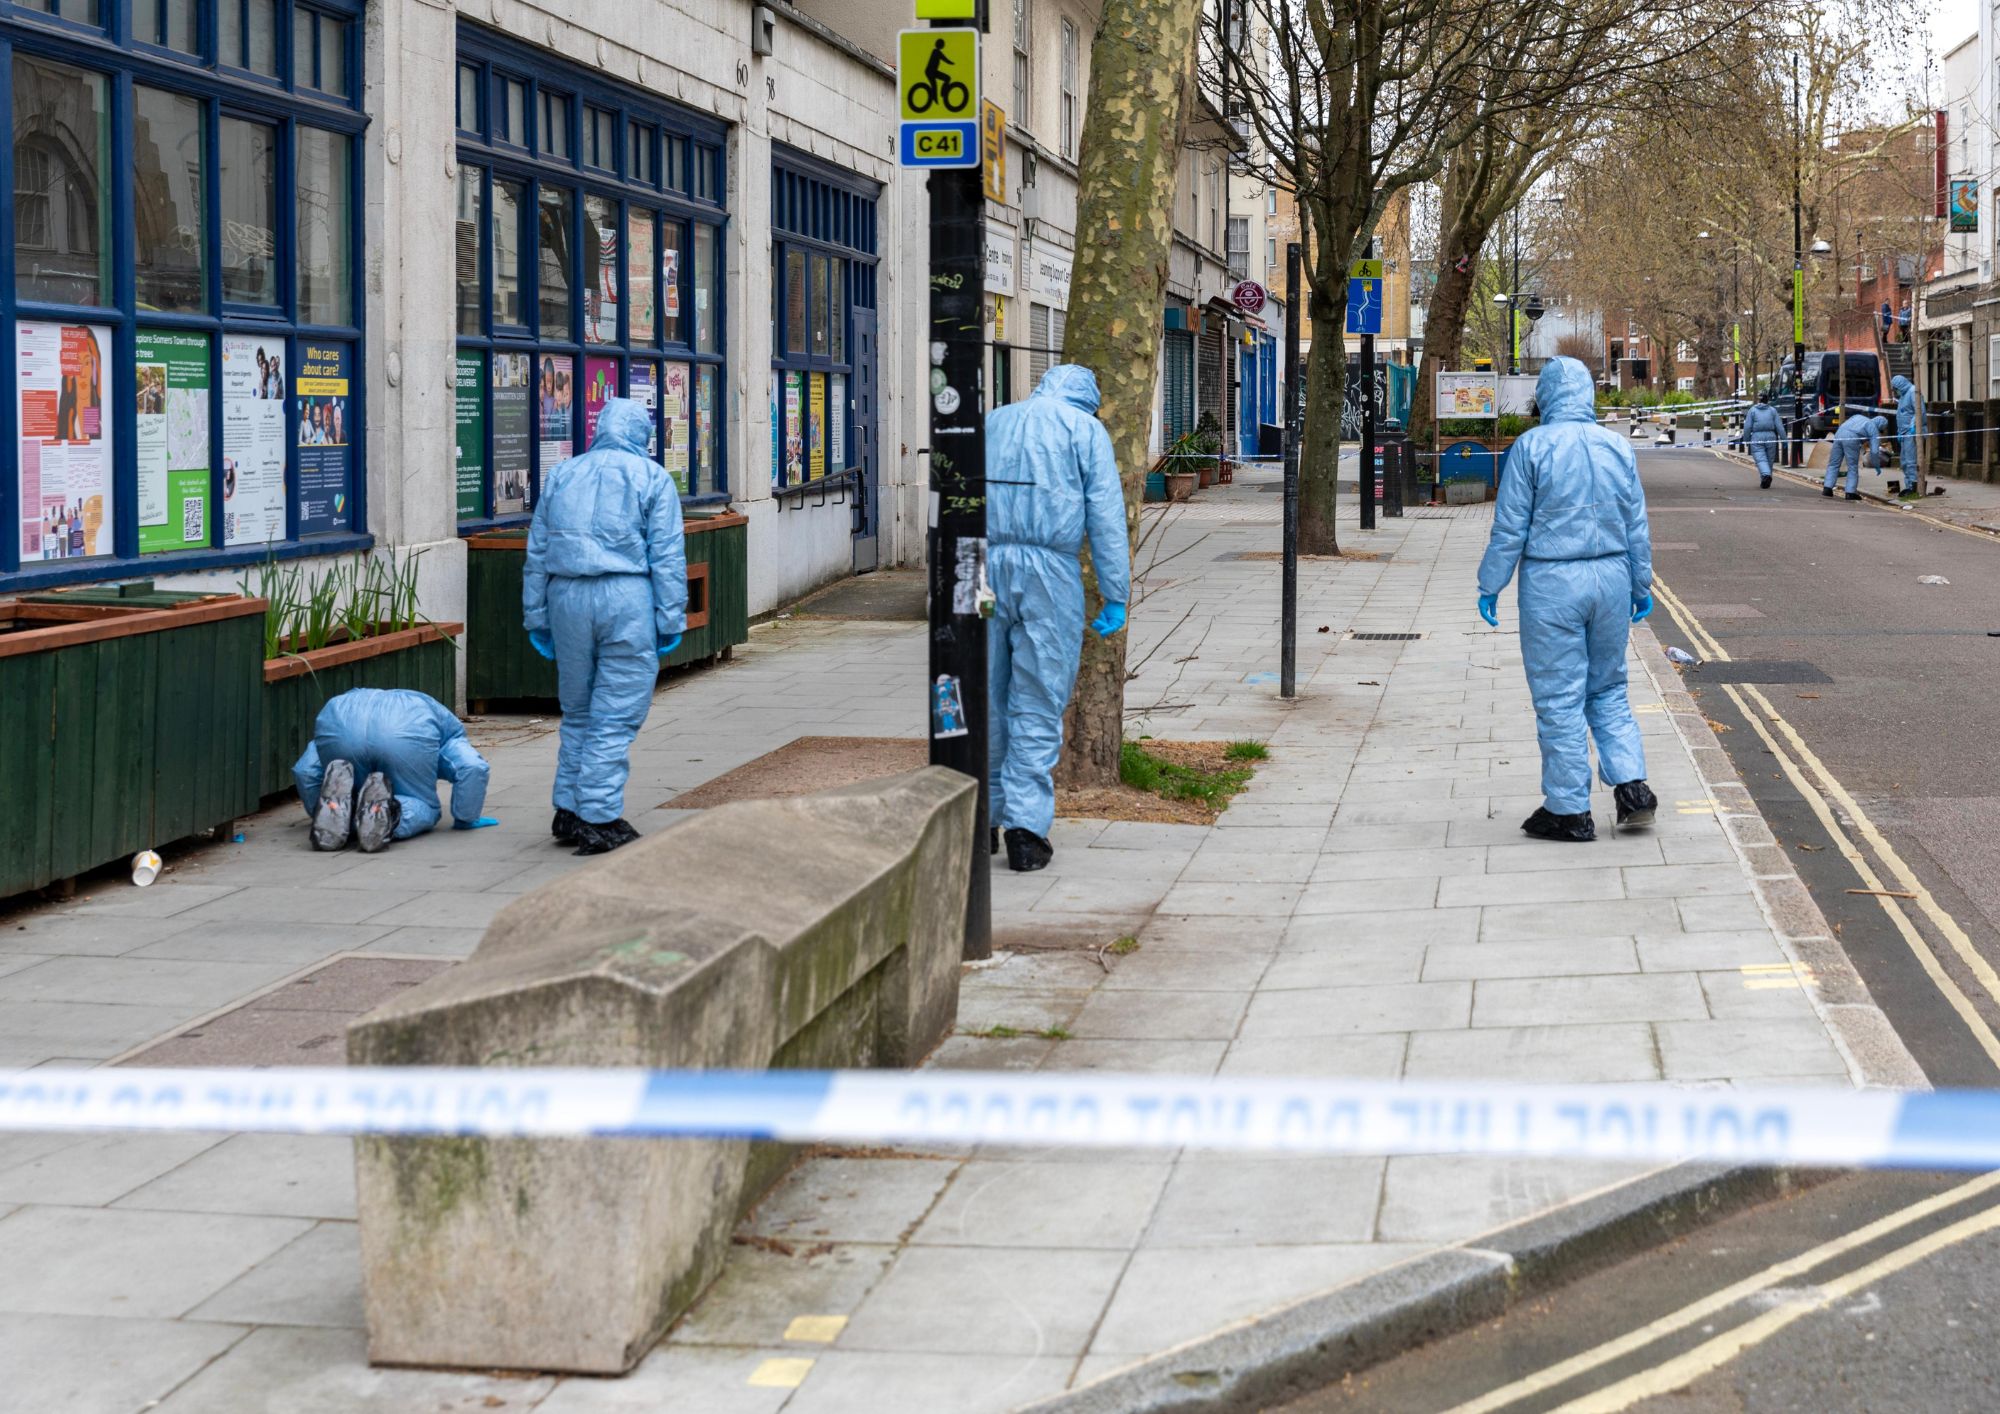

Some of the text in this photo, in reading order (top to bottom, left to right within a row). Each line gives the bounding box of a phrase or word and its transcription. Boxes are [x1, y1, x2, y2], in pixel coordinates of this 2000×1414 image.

[736, 58, 748, 87] 60
[766, 75, 775, 101] 58
[918, 136, 958, 153] C41
[153, 335, 173, 344] Somers
[173, 336, 187, 345] Town
[187, 336, 206, 348] through
[140, 350, 154, 358] trees
[307, 346, 339, 361] Who cares
[303, 362, 339, 376] about care?
